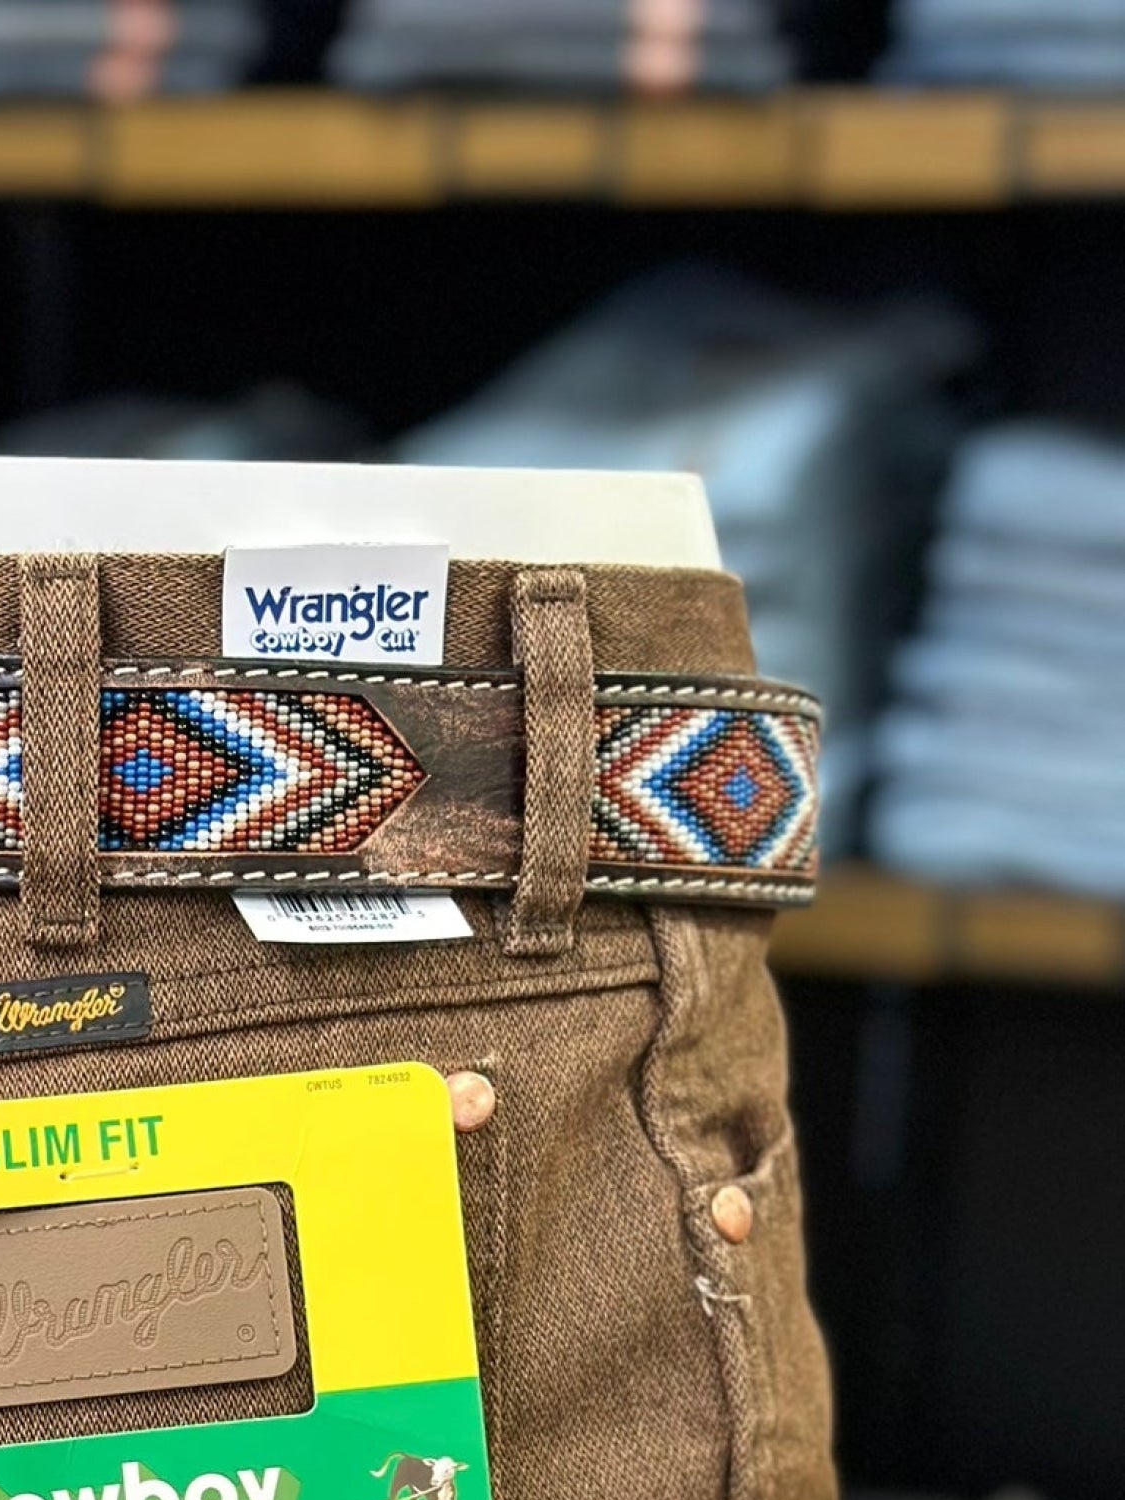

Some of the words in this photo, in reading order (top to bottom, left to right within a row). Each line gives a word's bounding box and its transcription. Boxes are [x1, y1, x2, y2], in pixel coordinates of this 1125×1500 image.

[245, 585, 429, 641] Wrangler
[251, 627, 345, 656] Cowboy
[376, 628, 417, 651] Cut
[306, 1079, 343, 1092] CWTUS
[368, 1072, 411, 1085] 7824932
[98, 1115, 163, 1161] FIT
